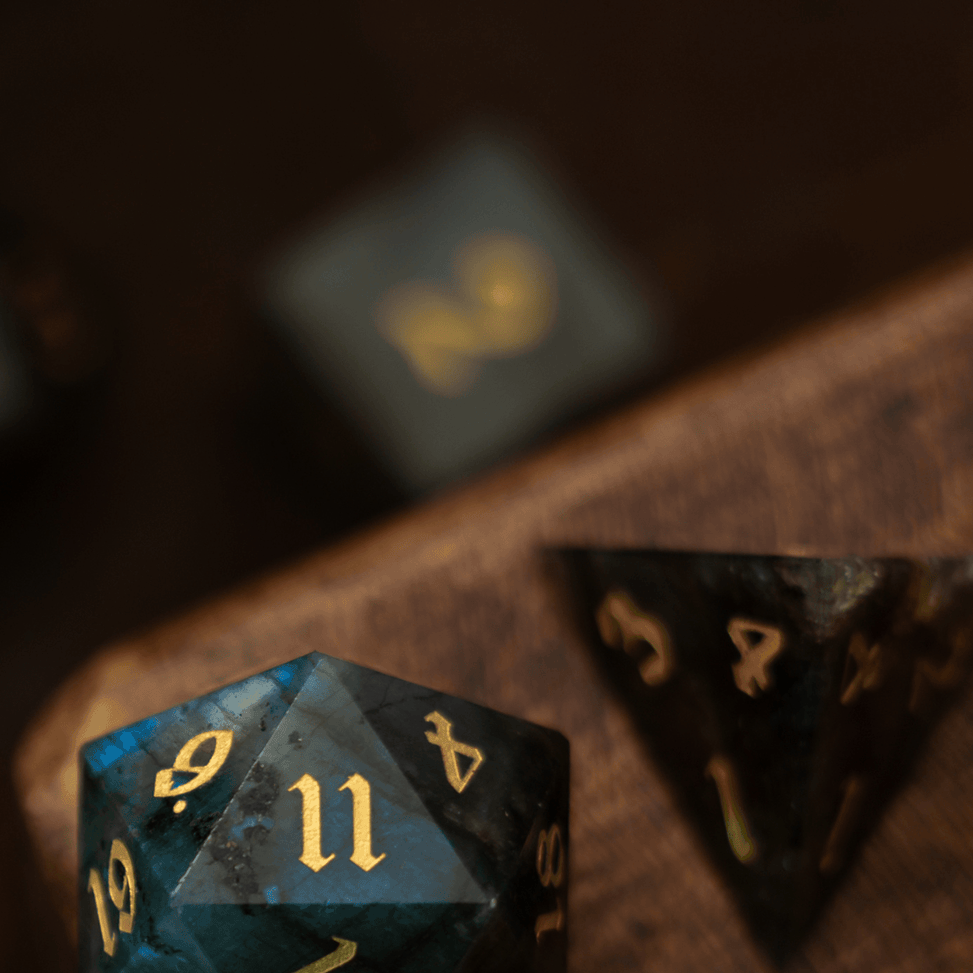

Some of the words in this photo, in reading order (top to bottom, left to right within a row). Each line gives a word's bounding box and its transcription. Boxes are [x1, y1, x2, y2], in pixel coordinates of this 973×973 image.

[597, 592, 675, 685] 3
[728, 618, 785, 698] 4
[424, 711, 483, 793] 4
[288, 773, 387, 872] 11
[705, 756, 756, 862] 1
[87, 839, 137, 957] 19
